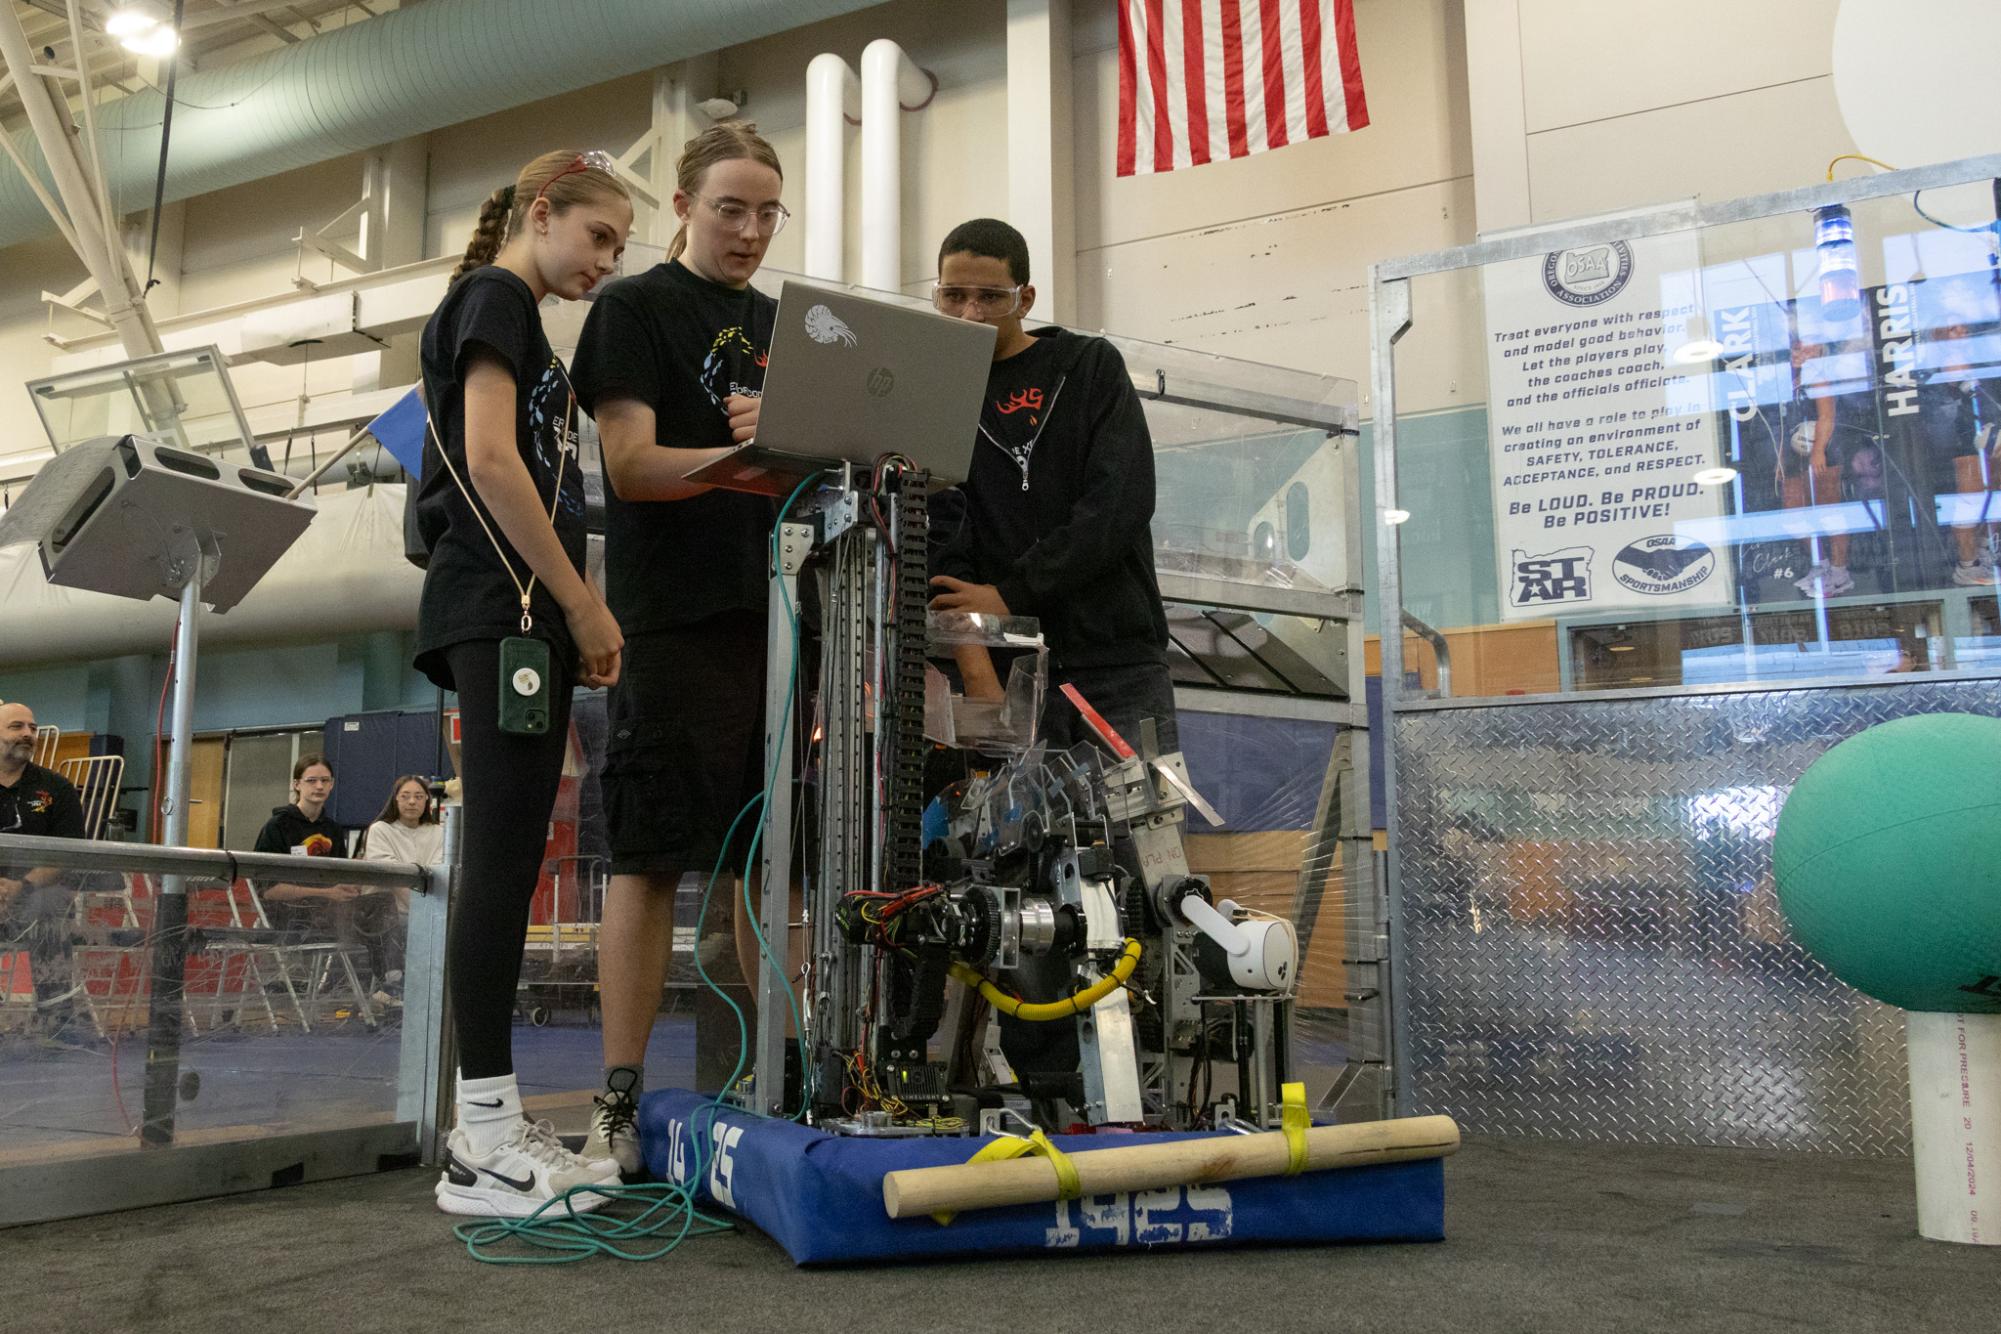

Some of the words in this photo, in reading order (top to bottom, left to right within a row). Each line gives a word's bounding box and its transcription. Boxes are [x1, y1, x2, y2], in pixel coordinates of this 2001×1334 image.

[1568, 253, 1606, 277] OSAA
[1557, 280, 1622, 304] ASSOCIATION
[1494, 329, 1530, 343] Treat
[1534, 319, 1598, 336] everyone
[1603, 312, 1634, 326] with
[1639, 304, 1695, 320] respect
[1504, 345, 1529, 358] and
[1533, 338, 1575, 354] model
[1579, 331, 1614, 348] good
[1876, 283, 1921, 417] HARRIS
[1522, 360, 1544, 372] Let
[1549, 355, 1571, 368] the
[1576, 349, 1629, 365] players
[1528, 375, 1550, 387] the
[1554, 367, 1613, 383] coaches
[1618, 360, 1665, 376] coach,
[1721, 305, 1758, 423] CLARK
[868, 367, 894, 399] hp
[1507, 394, 1532, 407] and
[1536, 389, 1558, 403] the
[1563, 381, 1620, 400] officials
[1501, 426, 1522, 437] We
[1526, 422, 1543, 434] all
[1548, 418, 1581, 431] have
[1586, 416, 1594, 426] a
[1599, 411, 1627, 424] role
[1632, 409, 1646, 420] to
[1504, 435, 1562, 453] creating
[1567, 435, 1584, 446] an
[1589, 423, 1681, 443] environment
[1686, 419, 1701, 431] of
[1526, 451, 1583, 467] SAFETY,
[1589, 440, 1679, 460] TOLERANCE,
[1503, 467, 1600, 487] ACCEPTANCE,
[1605, 462, 1631, 476] and
[1636, 454, 1706, 472] RESPECT.
[1509, 501, 1532, 515] Be
[1538, 494, 1593, 512] LOUD.
[1601, 491, 1624, 505] Be
[1631, 482, 1704, 501] PROUD.
[1543, 514, 1566, 529] Be
[1573, 502, 1671, 526] POSITIVE!
[1646, 537, 1676, 548] OSAA
[1619, 565, 1709, 593] SPORTSMANSHIP
[1773, 567, 1795, 580] #6
[1957, 1026, 1968, 1051] FOR
